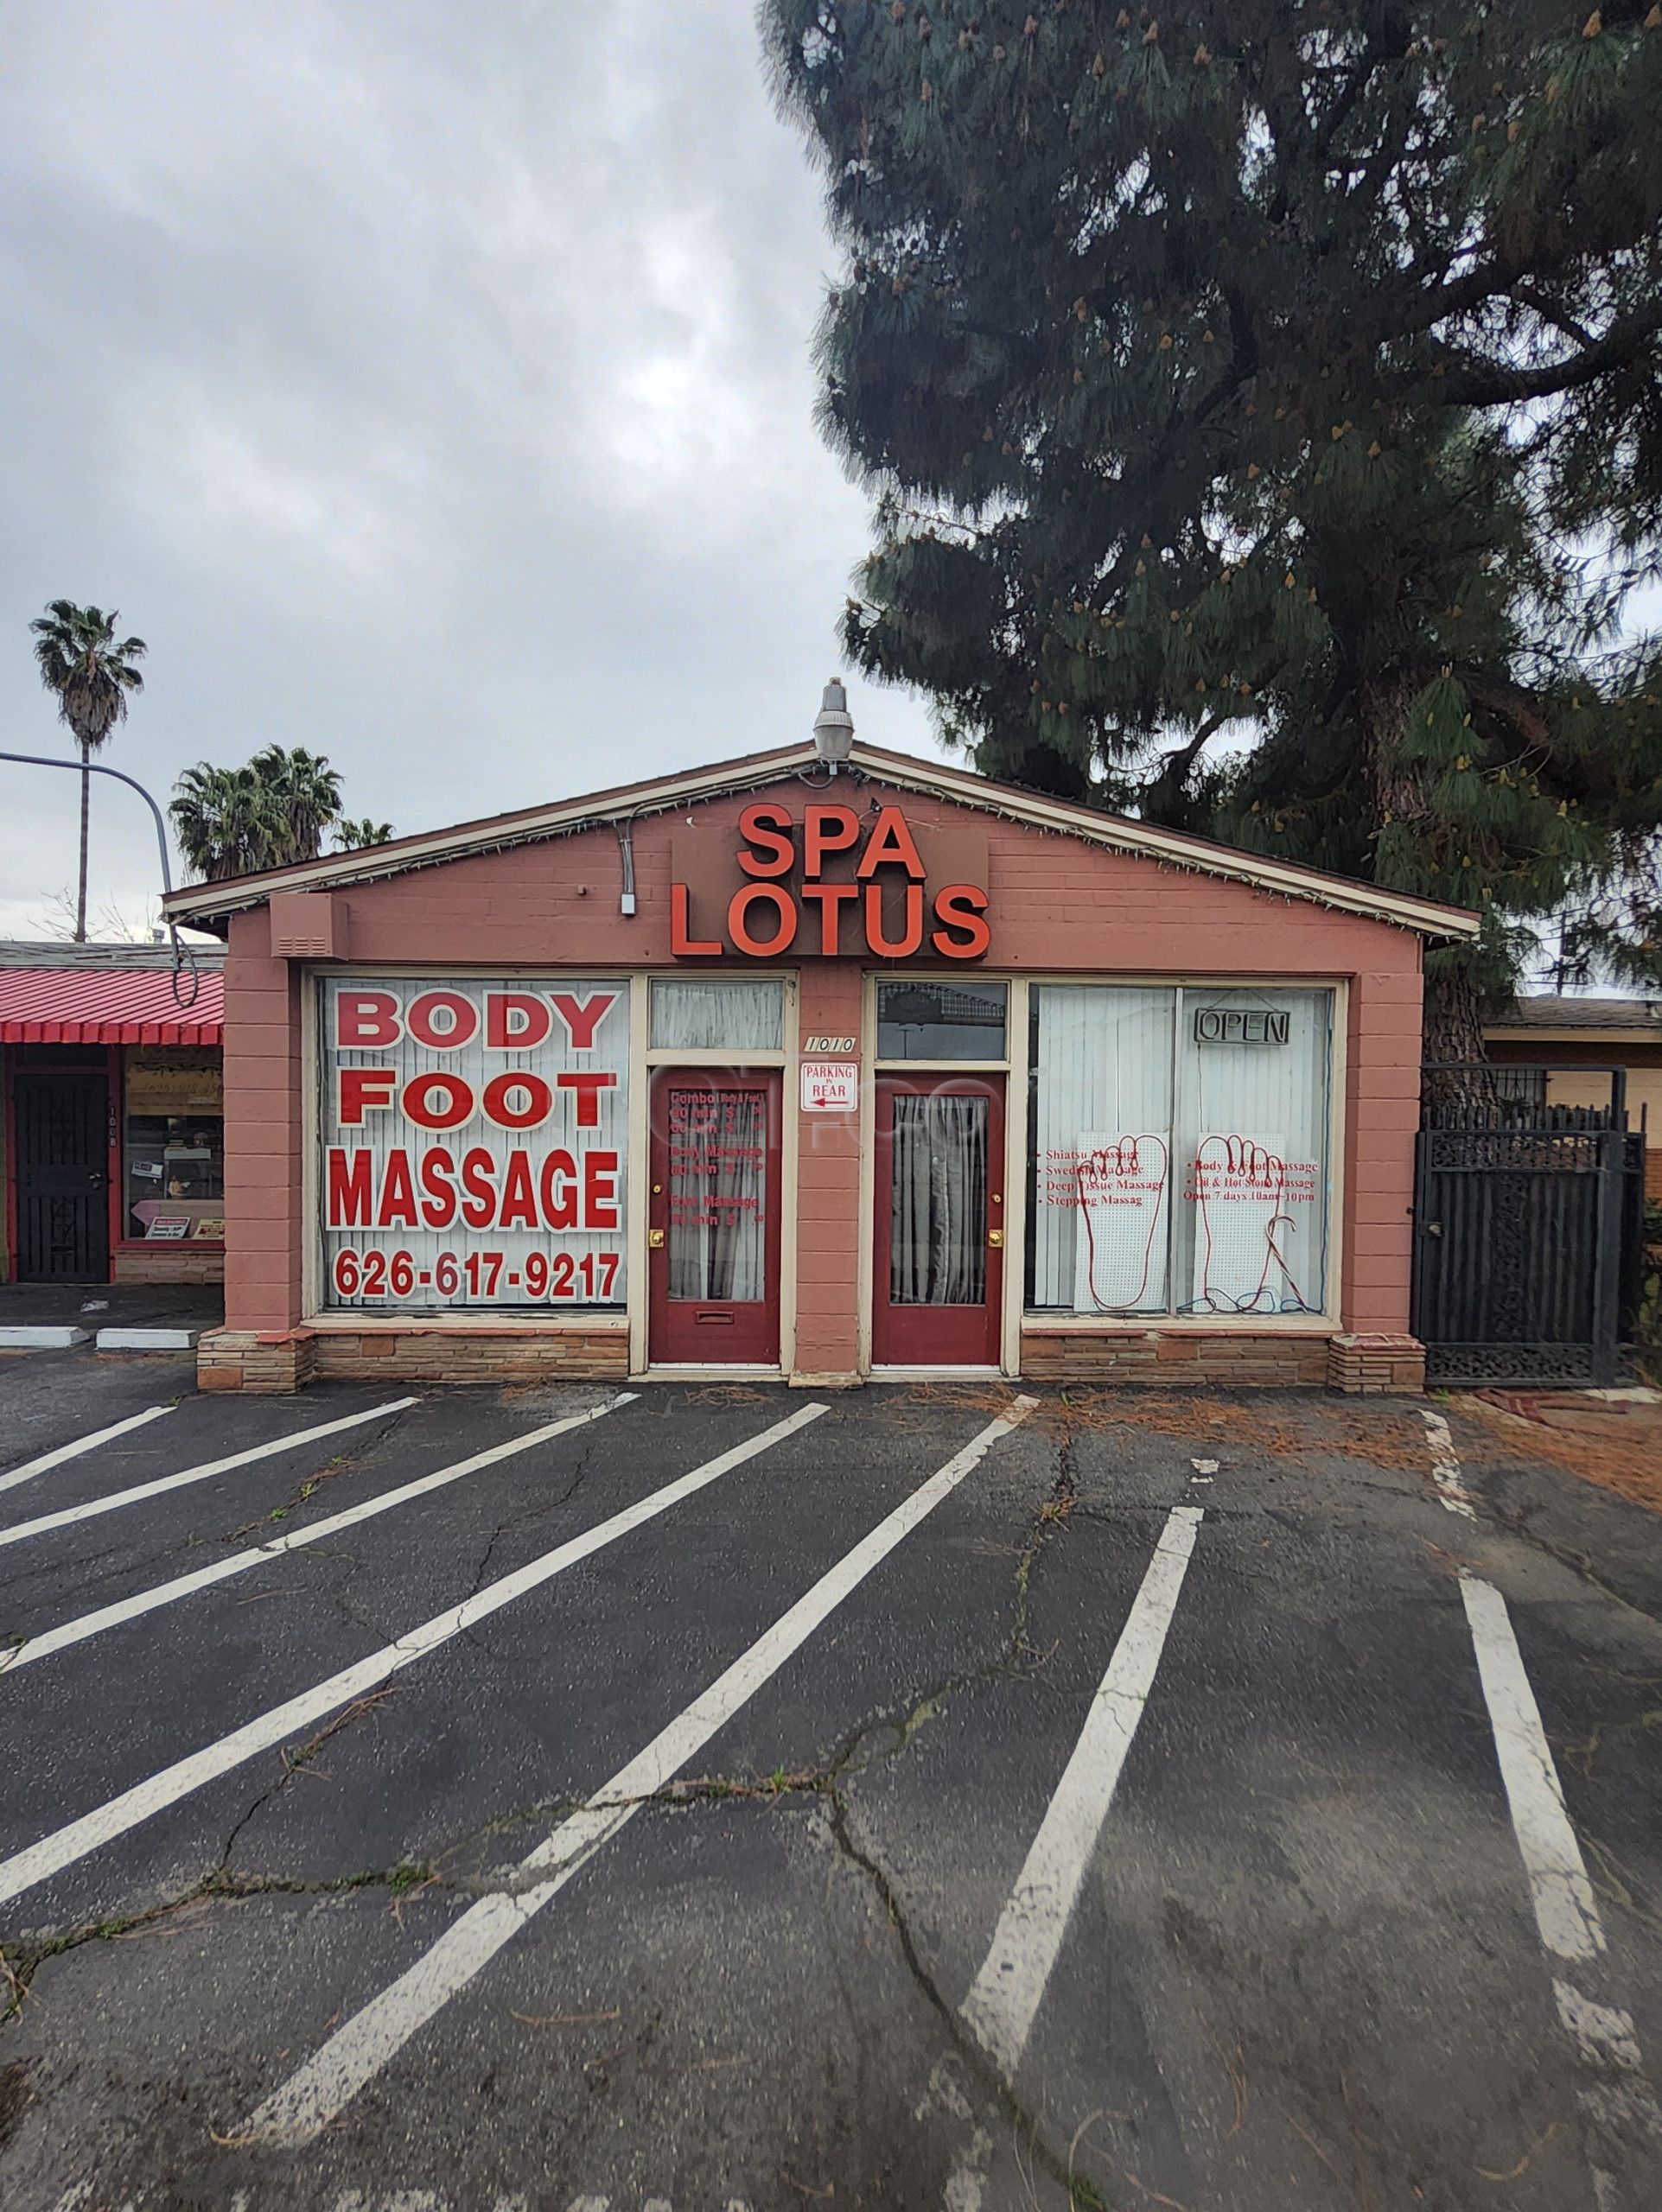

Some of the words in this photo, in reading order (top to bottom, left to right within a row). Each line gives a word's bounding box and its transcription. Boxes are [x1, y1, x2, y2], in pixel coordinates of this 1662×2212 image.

[736, 804, 927, 878] SPA
[671, 882, 990, 958] LOTUS
[337, 991, 616, 1049] BODY
[1199, 1011, 1286, 1043] OPEN
[809, 1038, 853, 1051] 1010
[806, 1066, 852, 1078] PARKING
[672, 1092, 714, 1103] Combo
[812, 1084, 846, 1096] REAR
[340, 1070, 617, 1128] FOOT
[706, 1145, 762, 1160] Massage
[1046, 1150, 1087, 1160] Shiatsu
[329, 1147, 618, 1230] MASSAGE
[1047, 1181, 1074, 1192] Deep
[1117, 1180, 1164, 1191] Massage
[1213, 1178, 1220, 1187] &
[1225, 1178, 1242, 1187] Hot
[703, 1195, 758, 1211] Massage
[1214, 1192, 1221, 1200] 7
[1224, 1192, 1247, 1202] days
[336, 1250, 620, 1297] 626-617-9217
